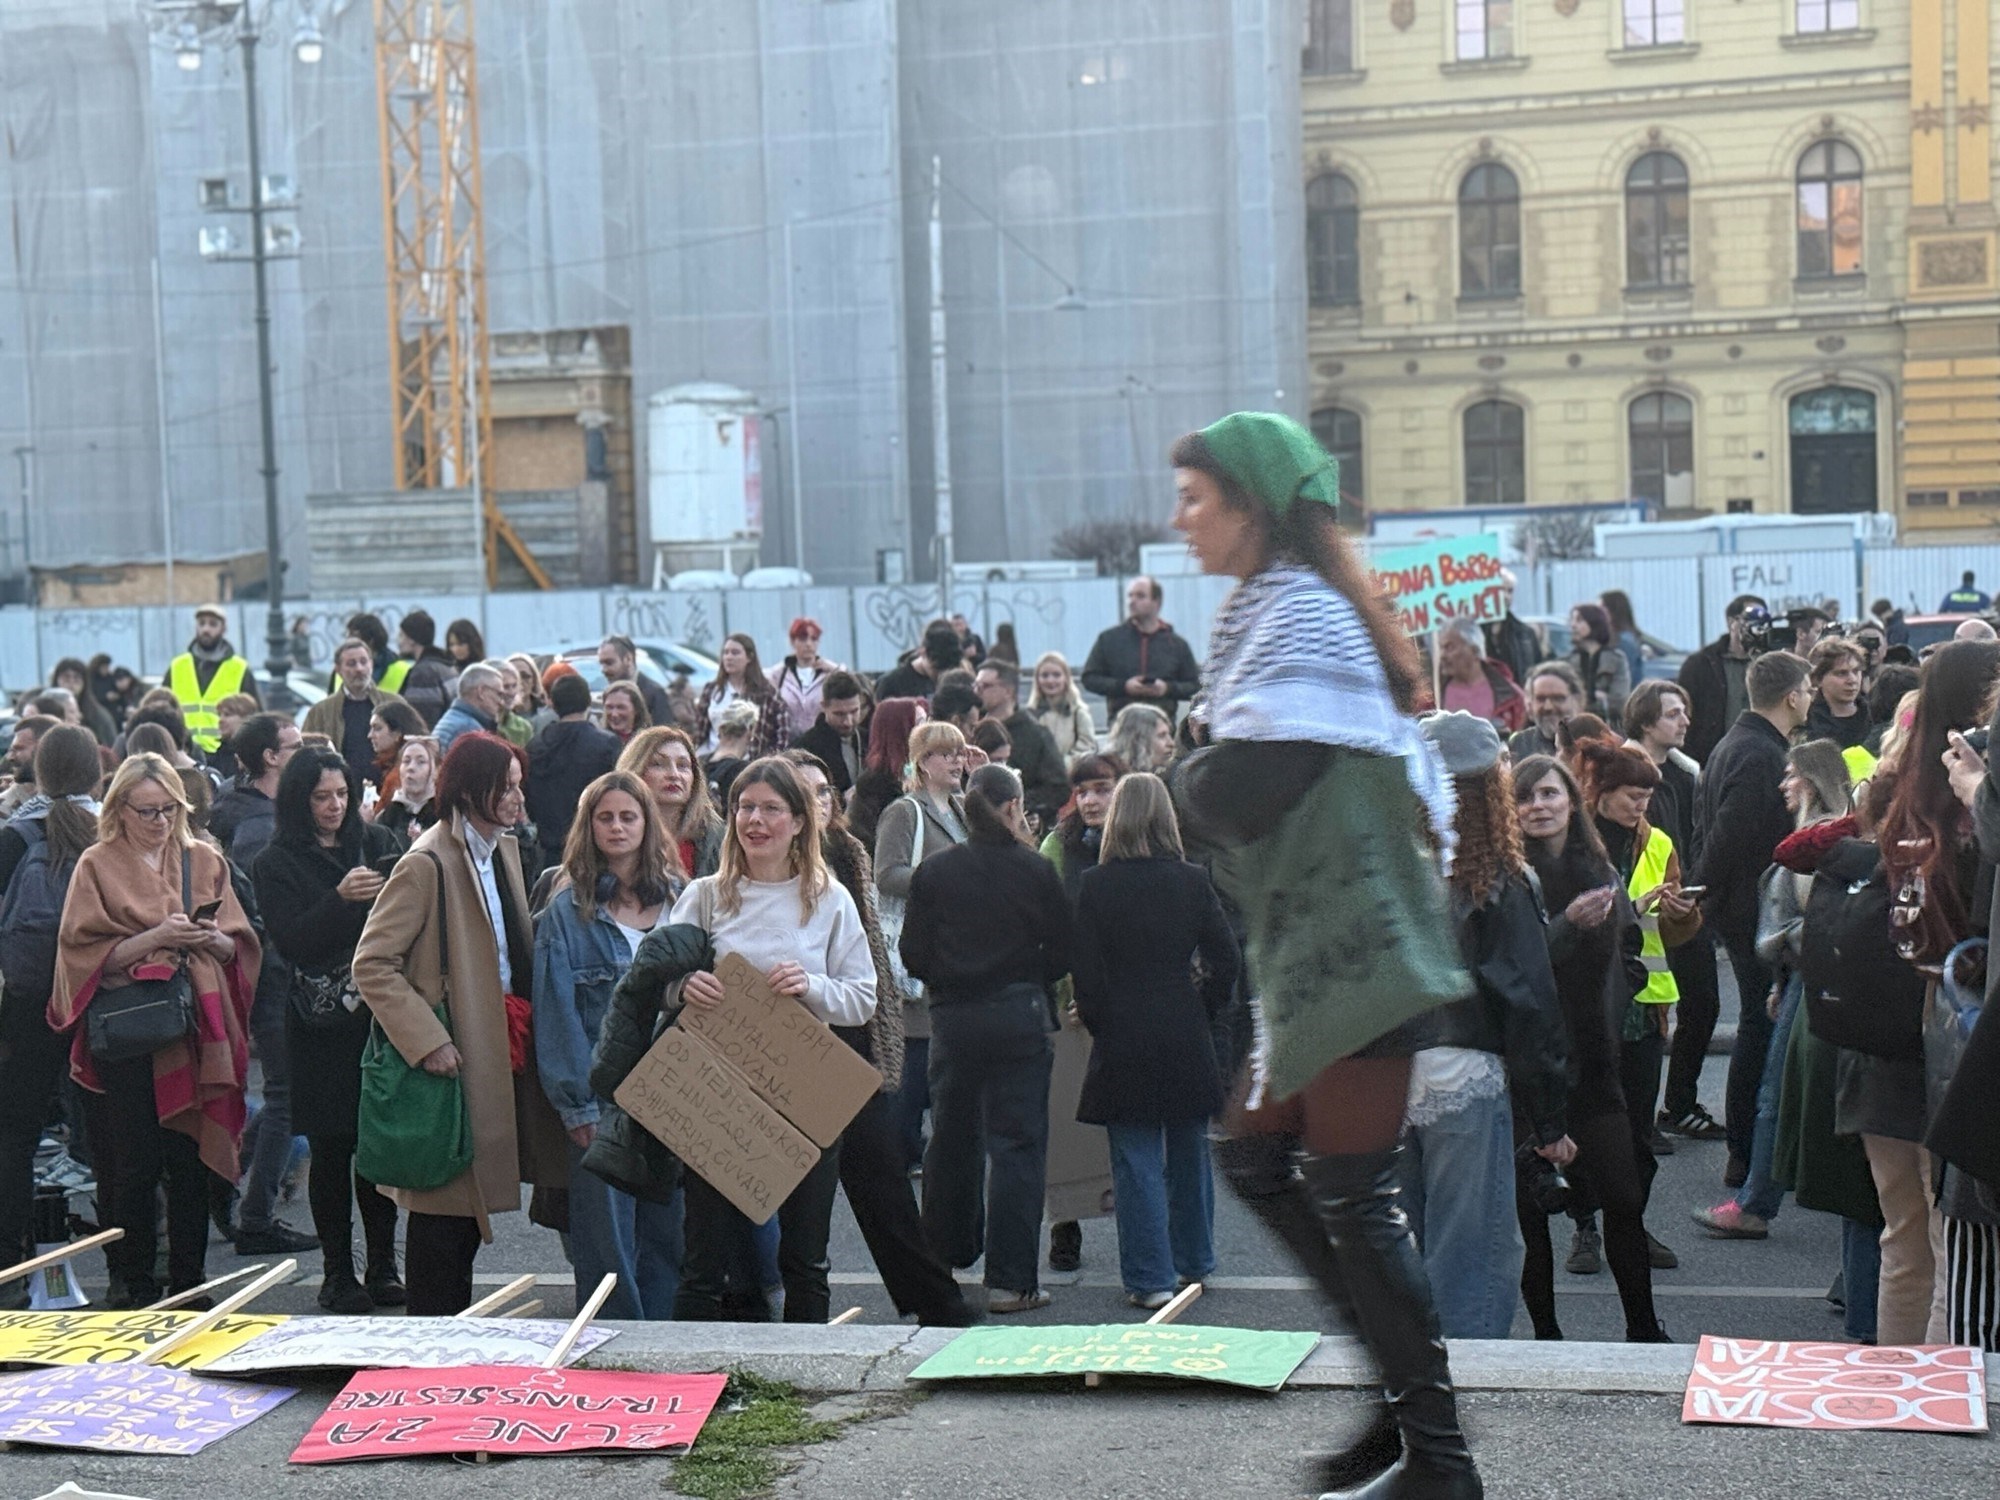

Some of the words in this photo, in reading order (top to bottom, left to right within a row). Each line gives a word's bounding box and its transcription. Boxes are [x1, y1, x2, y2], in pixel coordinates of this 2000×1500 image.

[1731, 564, 1793, 592] FALI
[717, 1006, 789, 1068] AMALO
[725, 965, 780, 1016] BILA
[781, 1012, 835, 1062] SAM
[689, 1013, 793, 1107] SILOVANA
[666, 1040, 691, 1064] OD
[699, 1061, 813, 1170] MEDICINSKOG
[1693, 1364, 1983, 1396] DOSTA
[327, 1416, 437, 1447] ZA
